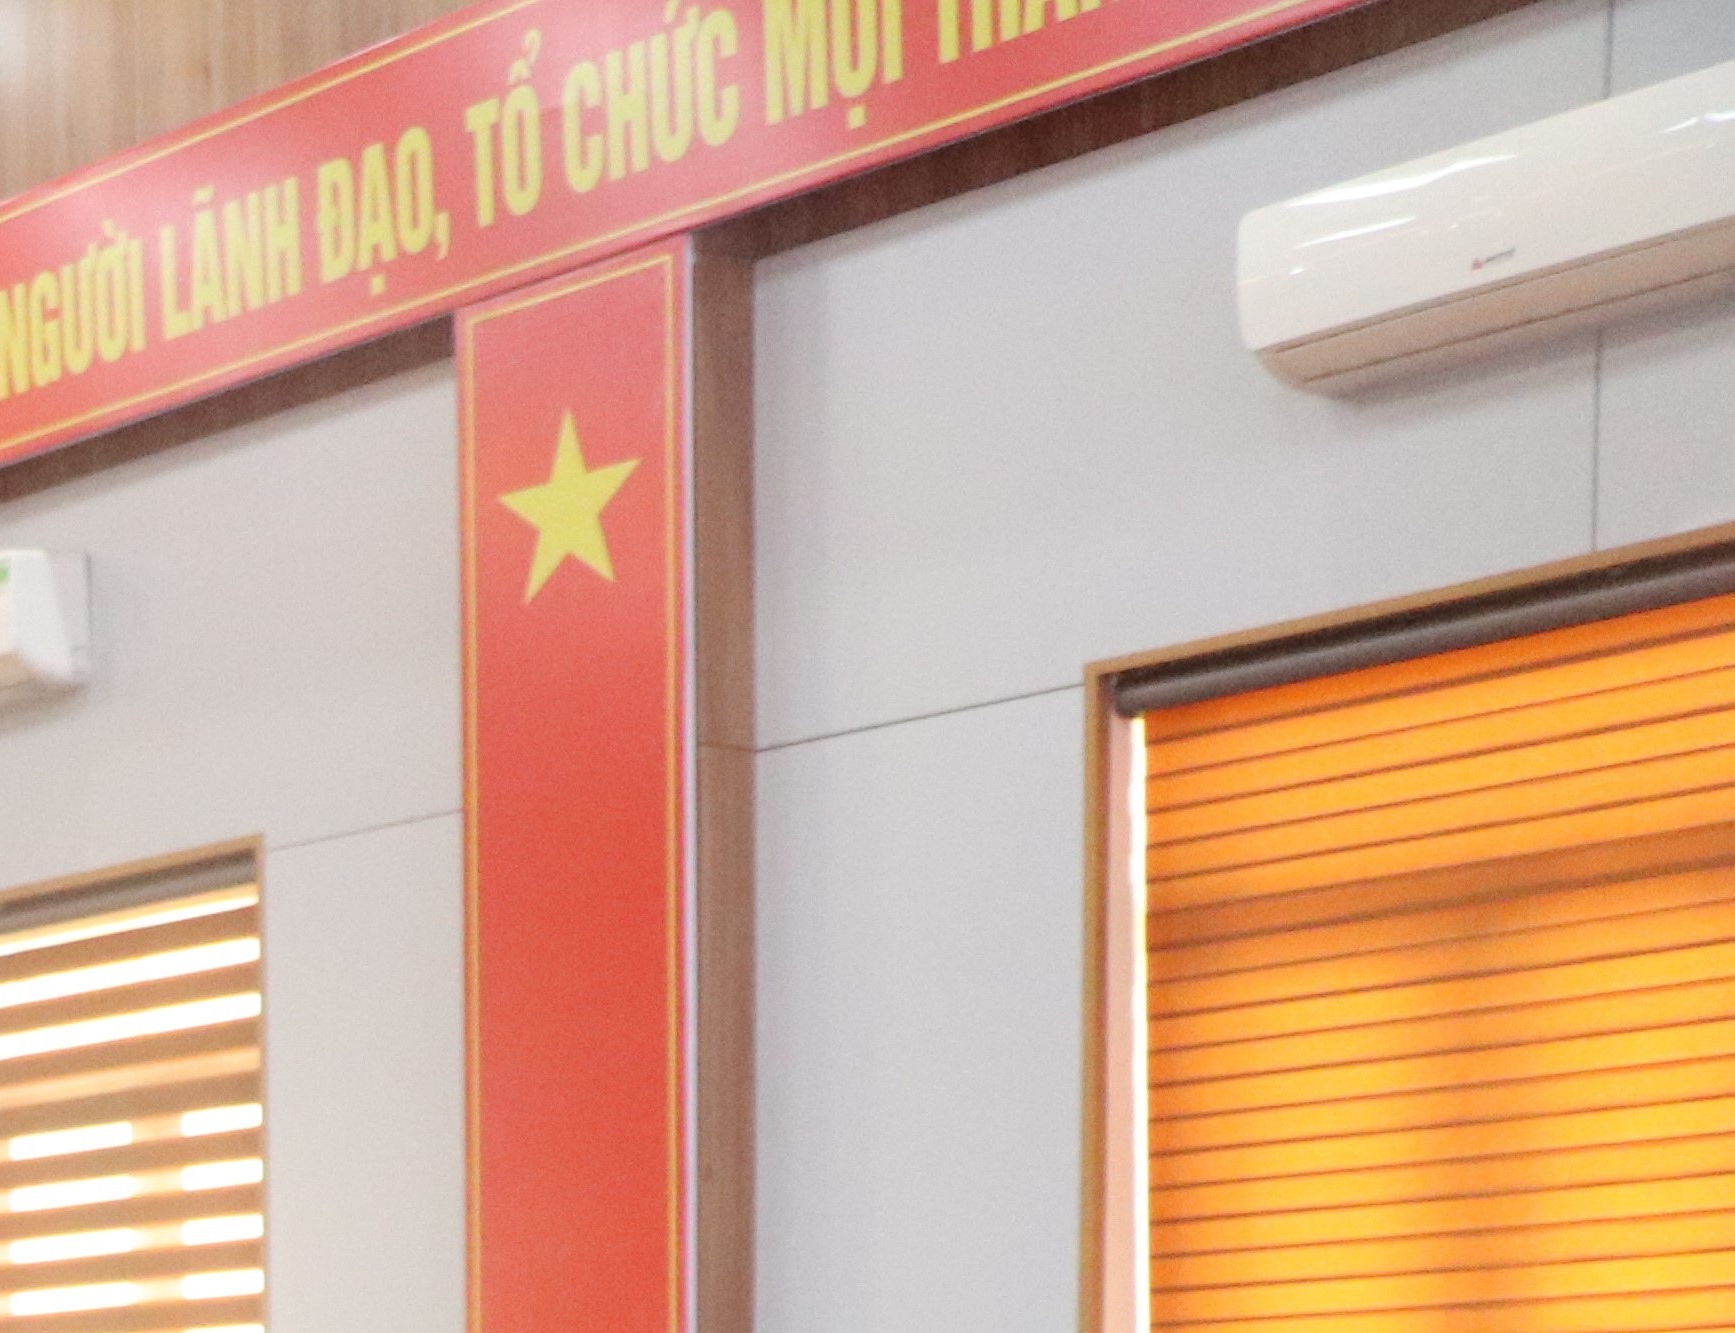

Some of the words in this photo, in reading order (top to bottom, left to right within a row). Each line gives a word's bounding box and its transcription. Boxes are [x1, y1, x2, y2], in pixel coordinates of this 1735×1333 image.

[160, 185, 301, 341] LÃNH
[317, 126, 451, 295] ĐẠO,
[465, 27, 542, 228] TỔ
[563, 0, 739, 193] CHỨC
